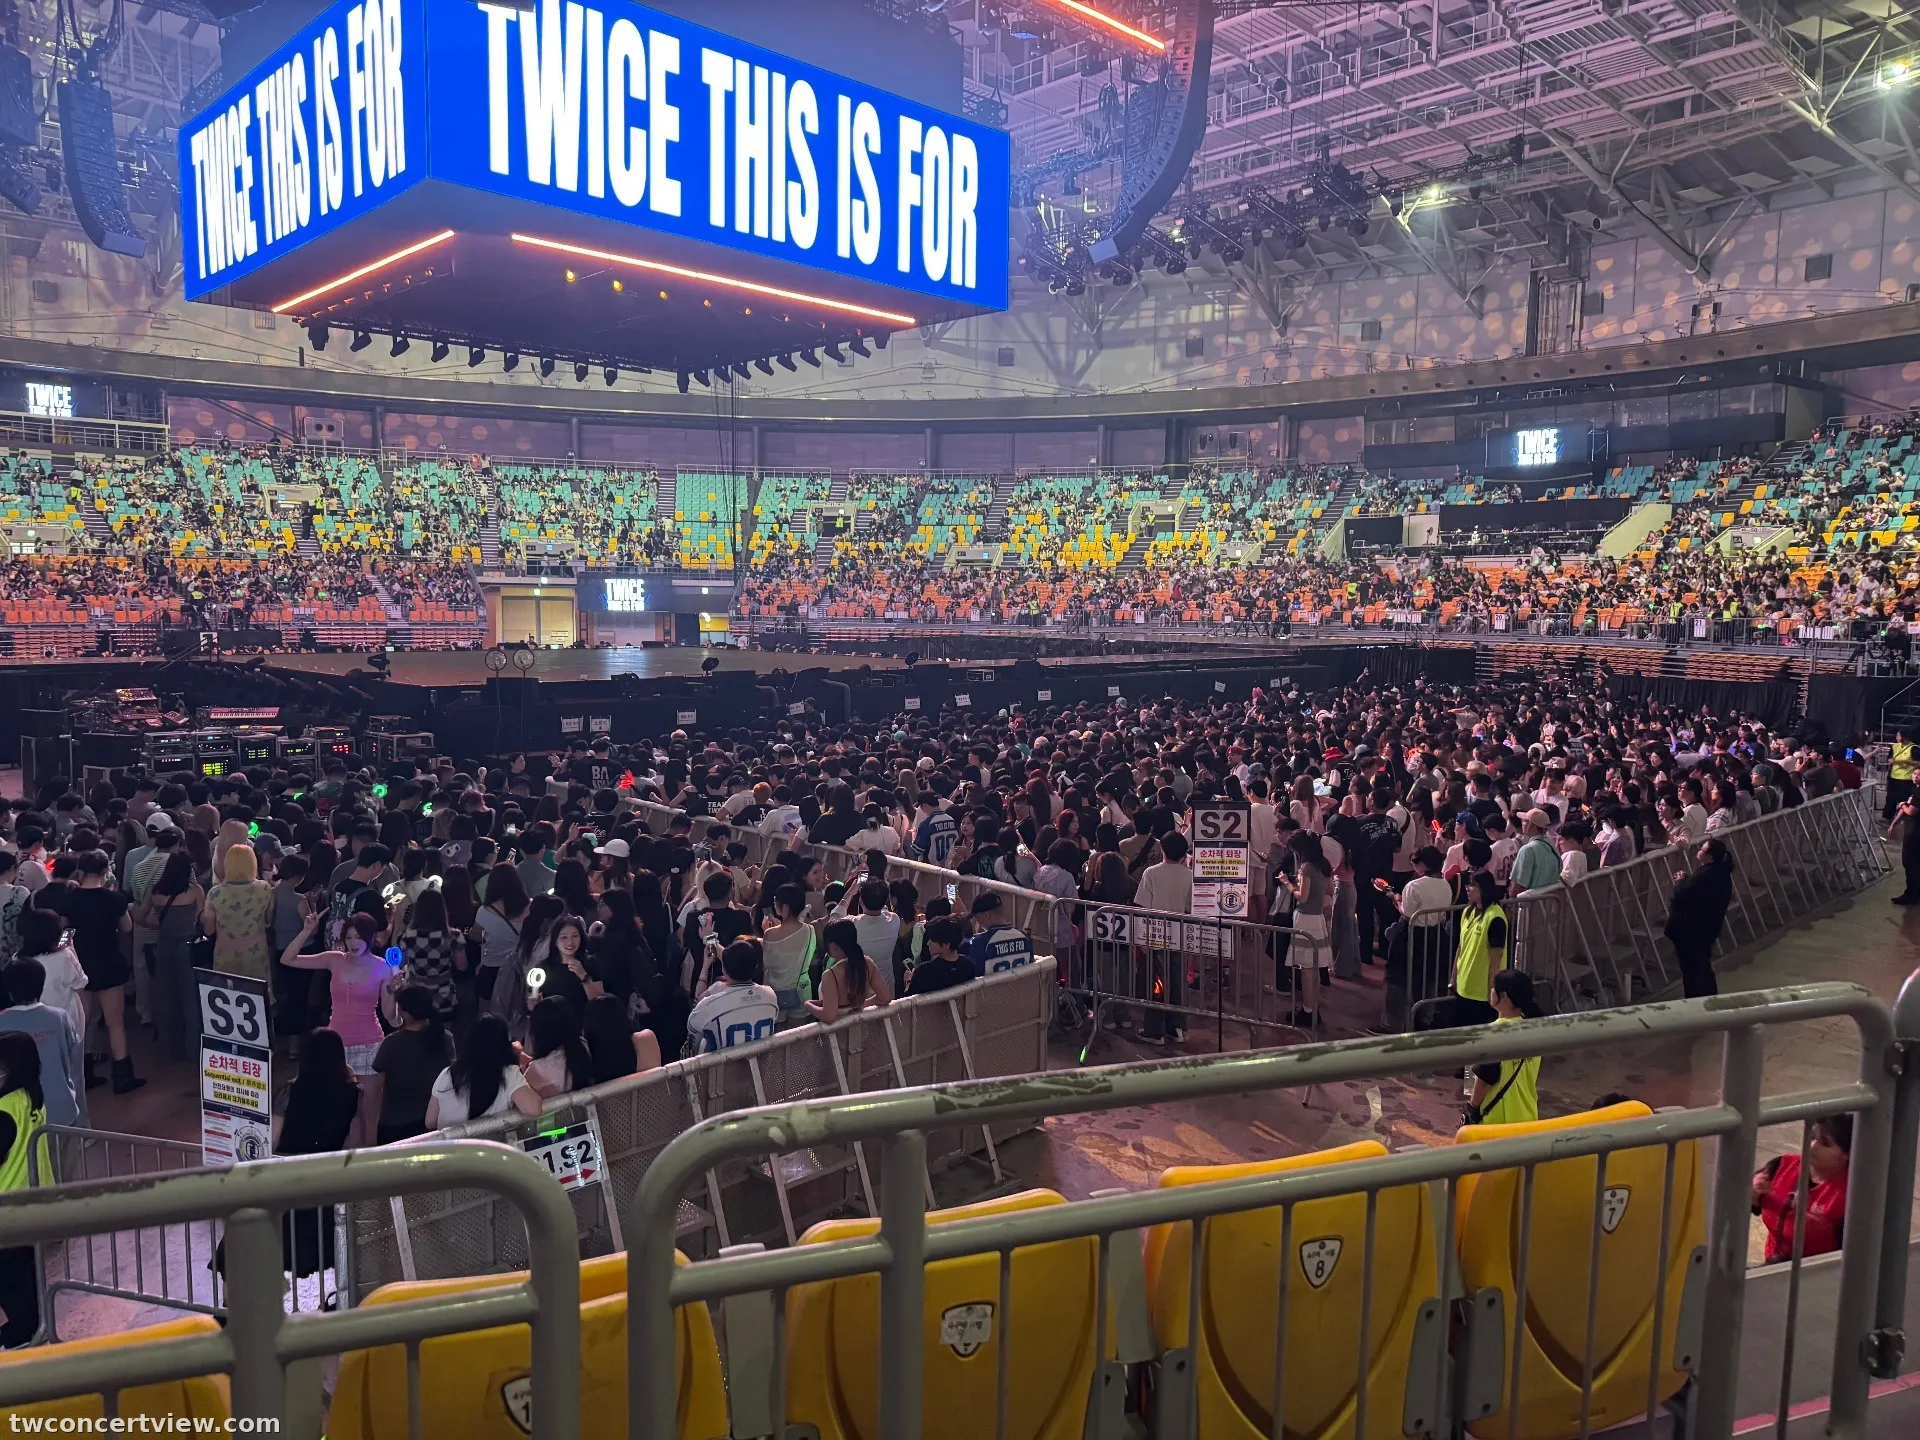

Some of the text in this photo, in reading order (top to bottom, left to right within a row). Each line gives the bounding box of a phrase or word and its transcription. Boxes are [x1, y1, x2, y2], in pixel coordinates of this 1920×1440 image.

[191, 0, 406, 279] TWICE THIS IS FOR
[478, 0, 979, 289] TWICE THIS IS FOR
[25, 383, 72, 408] TWICE
[1517, 428, 1558, 454] TWICE
[605, 578, 645, 600] TWICE
[1201, 811, 1241, 838] S2
[1200, 849, 1242, 858] 순차적 퇴장
[1095, 913, 1126, 941] S2
[995, 943, 1008, 955] THIS
[1010, 941, 1015, 952] IS
[207, 989, 260, 1042] S3
[209, 1054, 262, 1078] 순차적 퇴장
[534, 1140, 594, 1173] 1,S2
[1609, 1207, 1616, 1225] 7
[1315, 1260, 1325, 1278] 8
